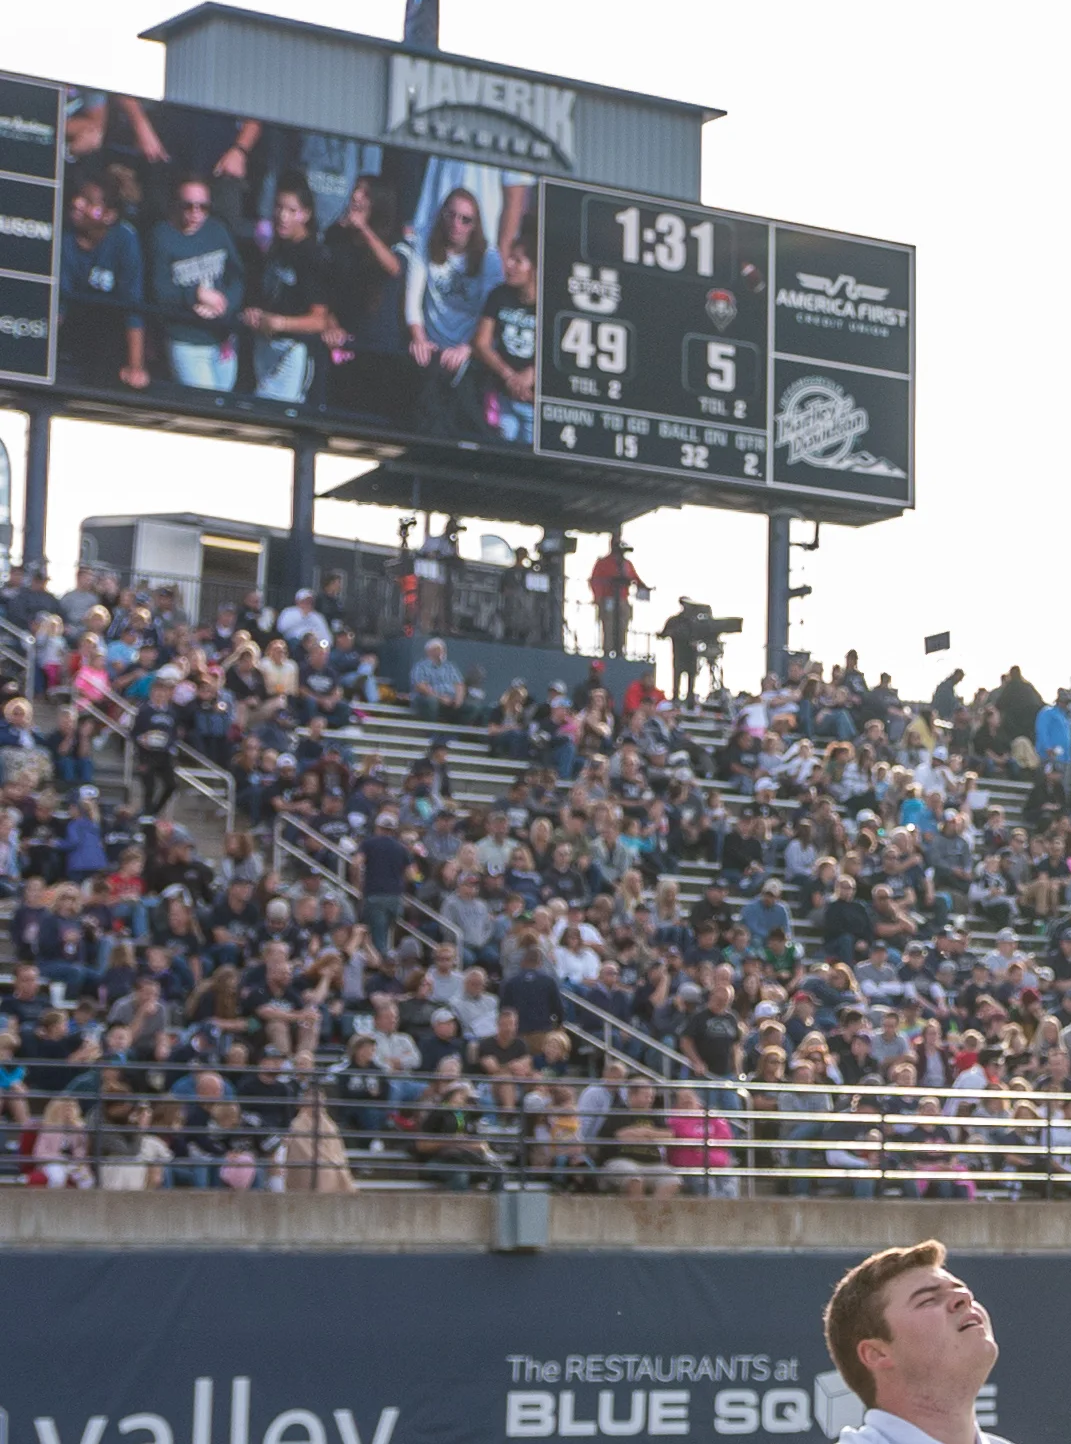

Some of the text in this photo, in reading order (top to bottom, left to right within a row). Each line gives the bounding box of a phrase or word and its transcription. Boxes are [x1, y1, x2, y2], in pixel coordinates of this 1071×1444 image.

[387, 55, 576, 171] MAVERIK
[615, 207, 714, 277] 1:31
[776, 288, 907, 327] AMERICA FIRST
[561, 318, 627, 374] 49
[707, 342, 736, 392] 5
[608, 380, 622, 400] 2
[734, 400, 747, 419] 2
[543, 405, 594, 426] DOWN
[601, 411, 623, 431] TO
[627, 417, 650, 435] GO
[659, 422, 698, 443] BALL
[704, 429, 728, 447] ON
[560, 425, 578, 449] 4
[615, 433, 638, 458] 15
[681, 444, 709, 469] 32
[508, 1355, 798, 1383] The RESTAURANTS at
[506, 1390, 690, 1437] BLUE
